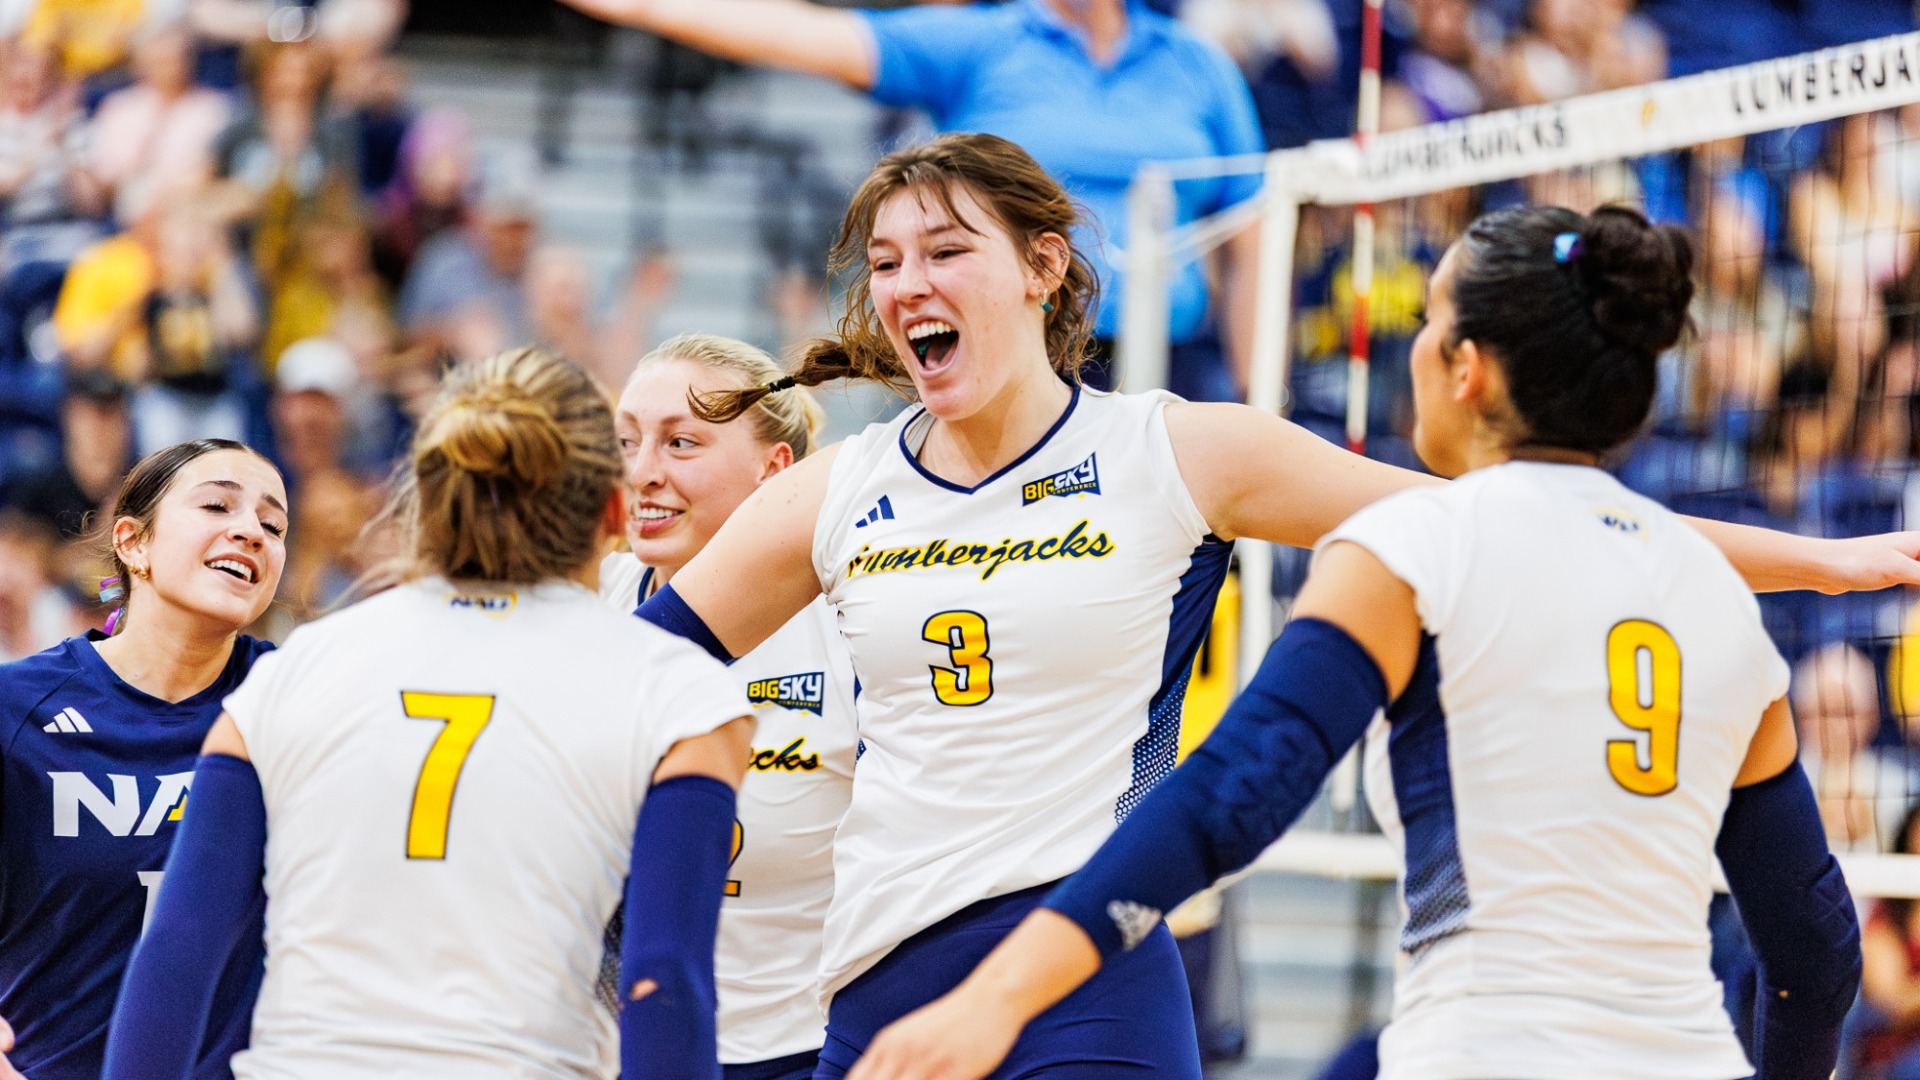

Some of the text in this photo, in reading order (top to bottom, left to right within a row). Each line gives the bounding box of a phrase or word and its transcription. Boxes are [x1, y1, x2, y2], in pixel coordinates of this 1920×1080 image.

[1731, 46, 1920, 115] LUMBERJA
[922, 609, 994, 707] 3
[1606, 617, 1682, 797] 9
[400, 690, 496, 861] 7
